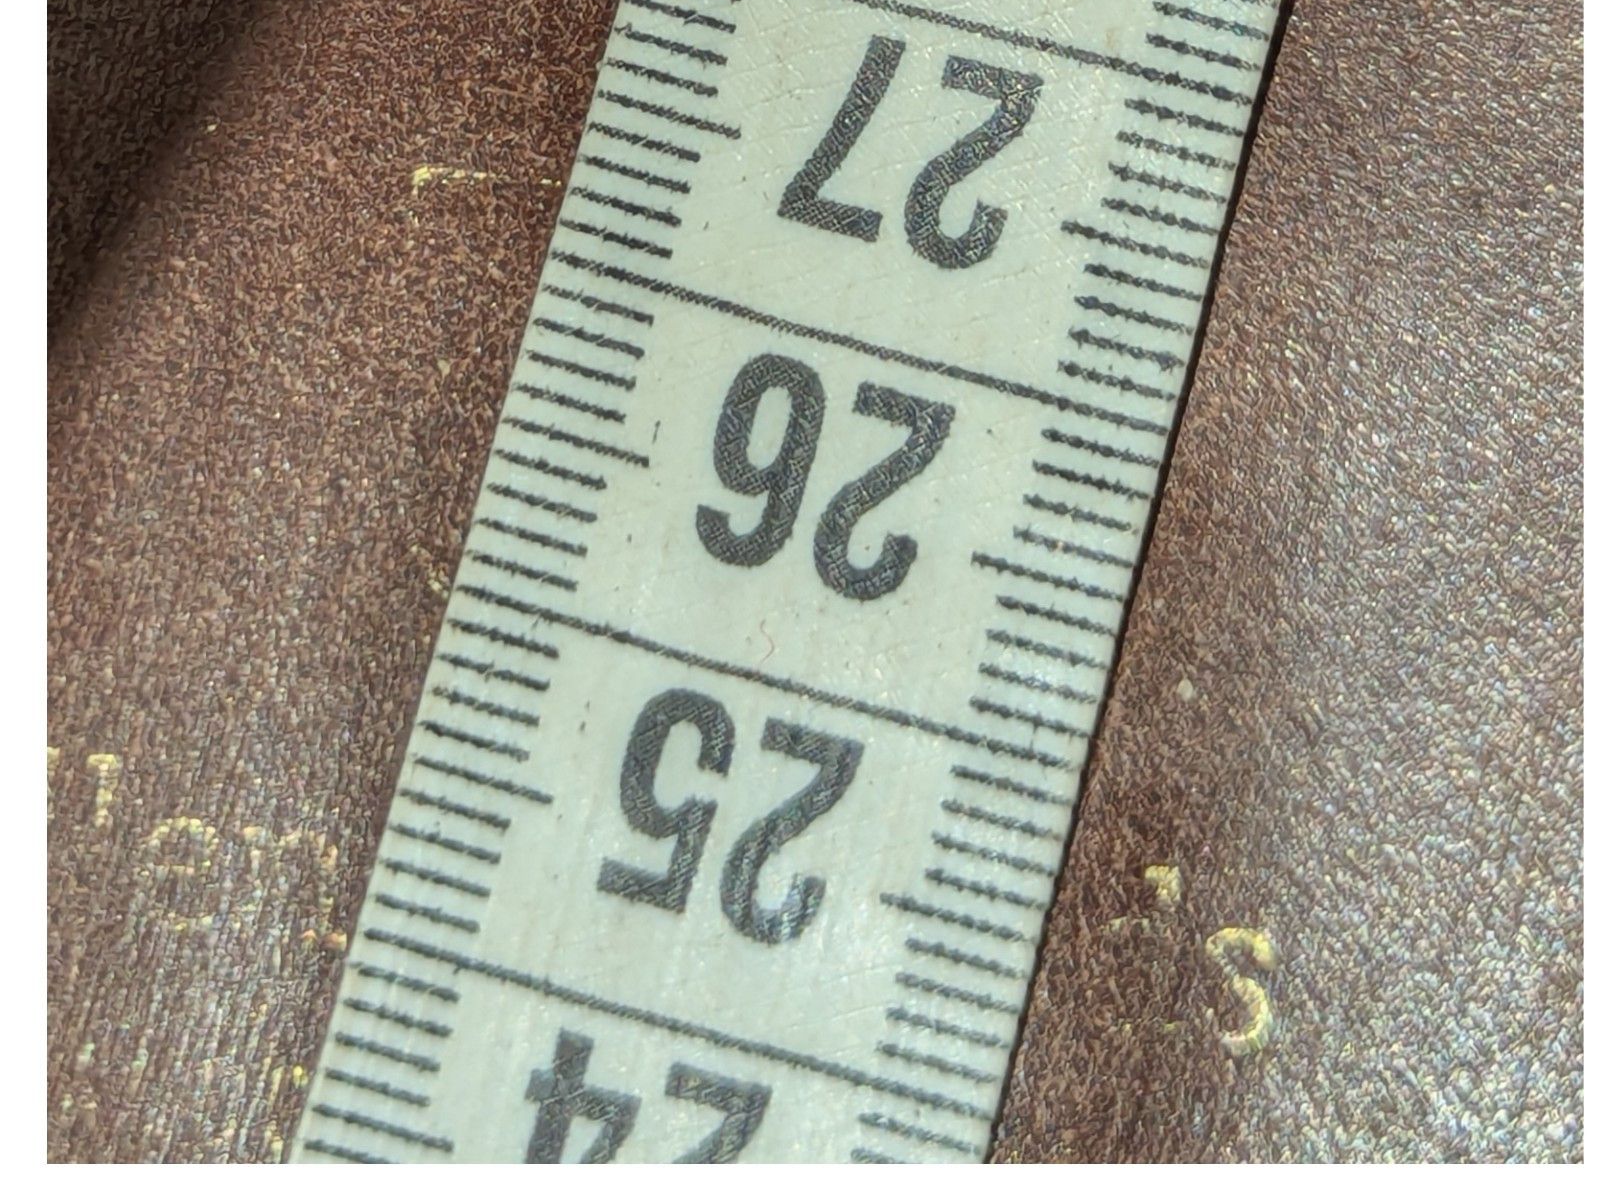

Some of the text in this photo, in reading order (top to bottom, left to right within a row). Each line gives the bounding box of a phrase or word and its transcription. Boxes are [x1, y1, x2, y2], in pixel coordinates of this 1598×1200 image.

[776, 34, 1045, 270] 27
[695, 352, 956, 603] 26
[595, 687, 865, 945] 25
